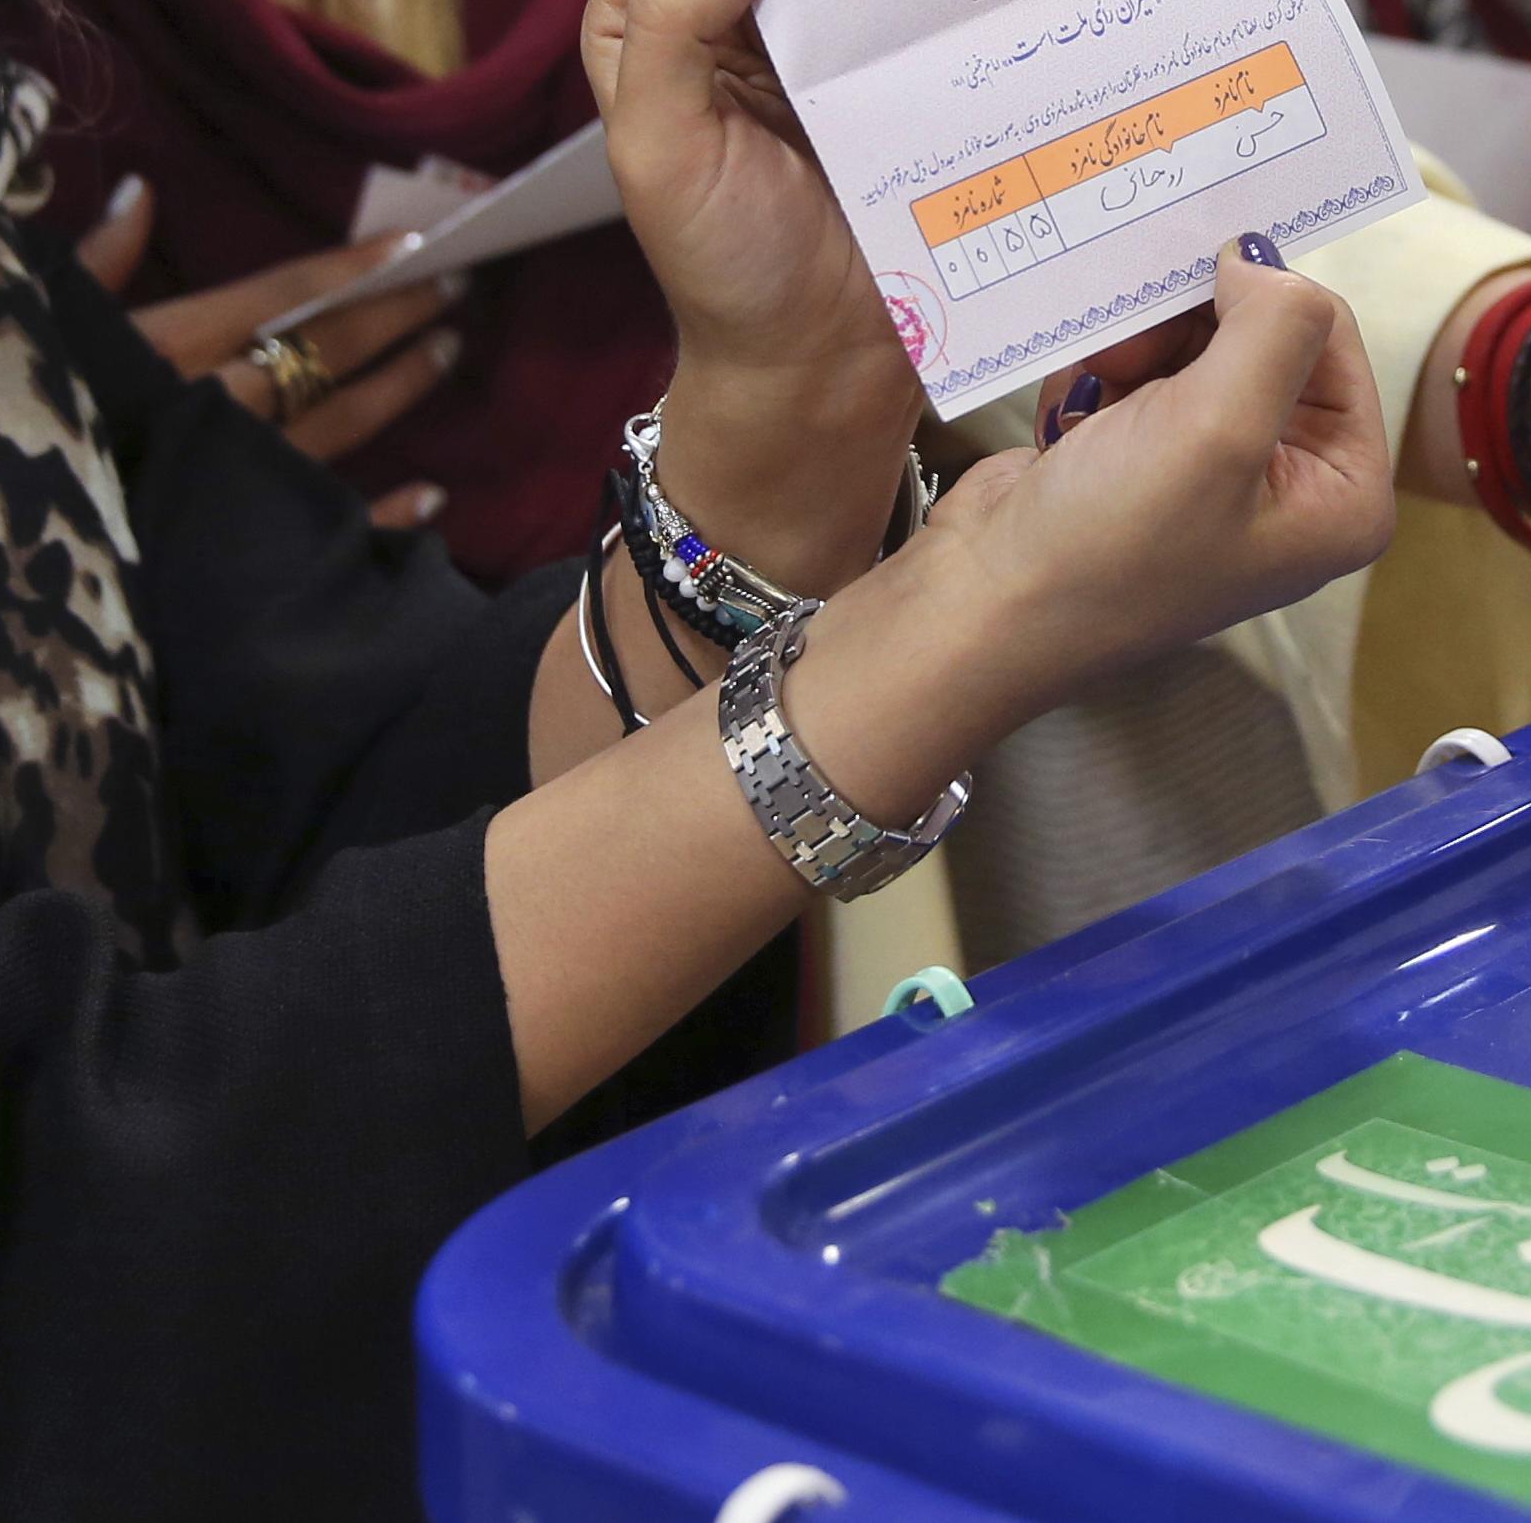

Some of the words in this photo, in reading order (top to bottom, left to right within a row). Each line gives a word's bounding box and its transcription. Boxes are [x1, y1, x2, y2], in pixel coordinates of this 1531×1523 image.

[1053, 11, 1089, 46] ملت
[1212, 29, 1228, 55] نام
[1230, 21, 1246, 45] نام
[1179, 31, 1213, 68] خانوادگی
[1141, 61, 1161, 82] مورد
[1234, 69, 1256, 97] نام
[1067, 88, 1086, 115] شماره
[1084, 93, 1095, 111] با
[1092, 85, 1110, 107] همراه
[1106, 80, 1118, 96] را
[1213, 76, 1240, 117] نامزد
[1144, 111, 1165, 140] نام
[1098, 117, 1147, 169] خانوادگی
[927, 151, 956, 177] جدول
[1069, 140, 1099, 181] نامزد
[979, 173, 1007, 214] شماره
[952, 188, 980, 231] نامزد
